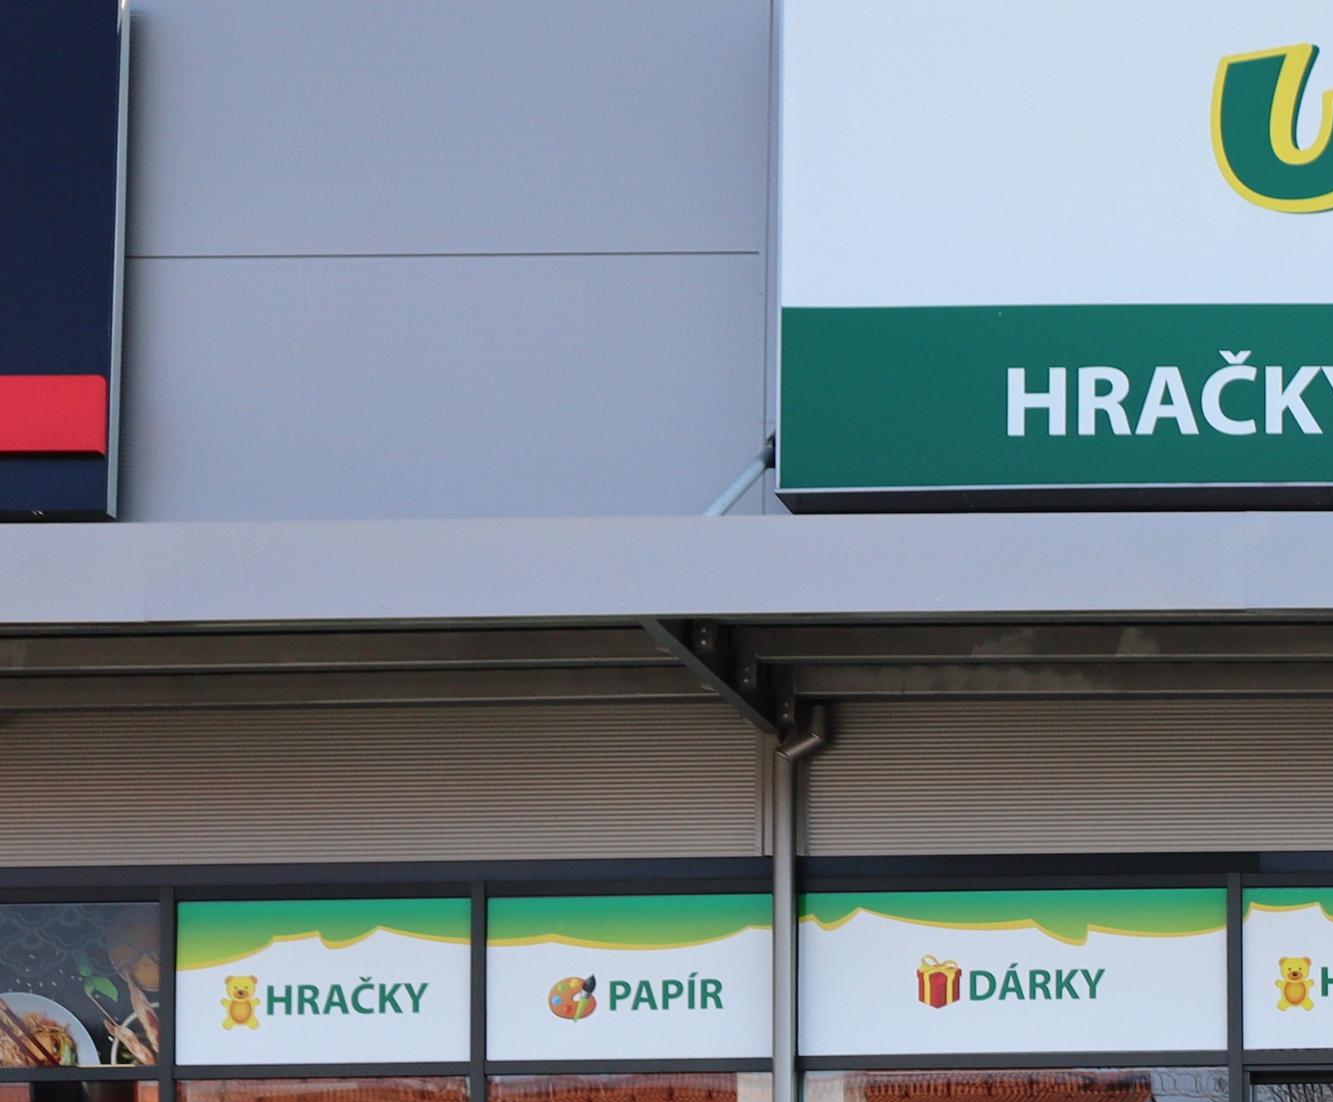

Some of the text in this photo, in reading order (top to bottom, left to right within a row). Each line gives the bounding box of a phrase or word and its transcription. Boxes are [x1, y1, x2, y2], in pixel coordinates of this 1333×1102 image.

[266, 975, 429, 1016] HRAČKY
[608, 972, 724, 1012] PAPÍR
[969, 962, 1106, 1001] DÁRKY
